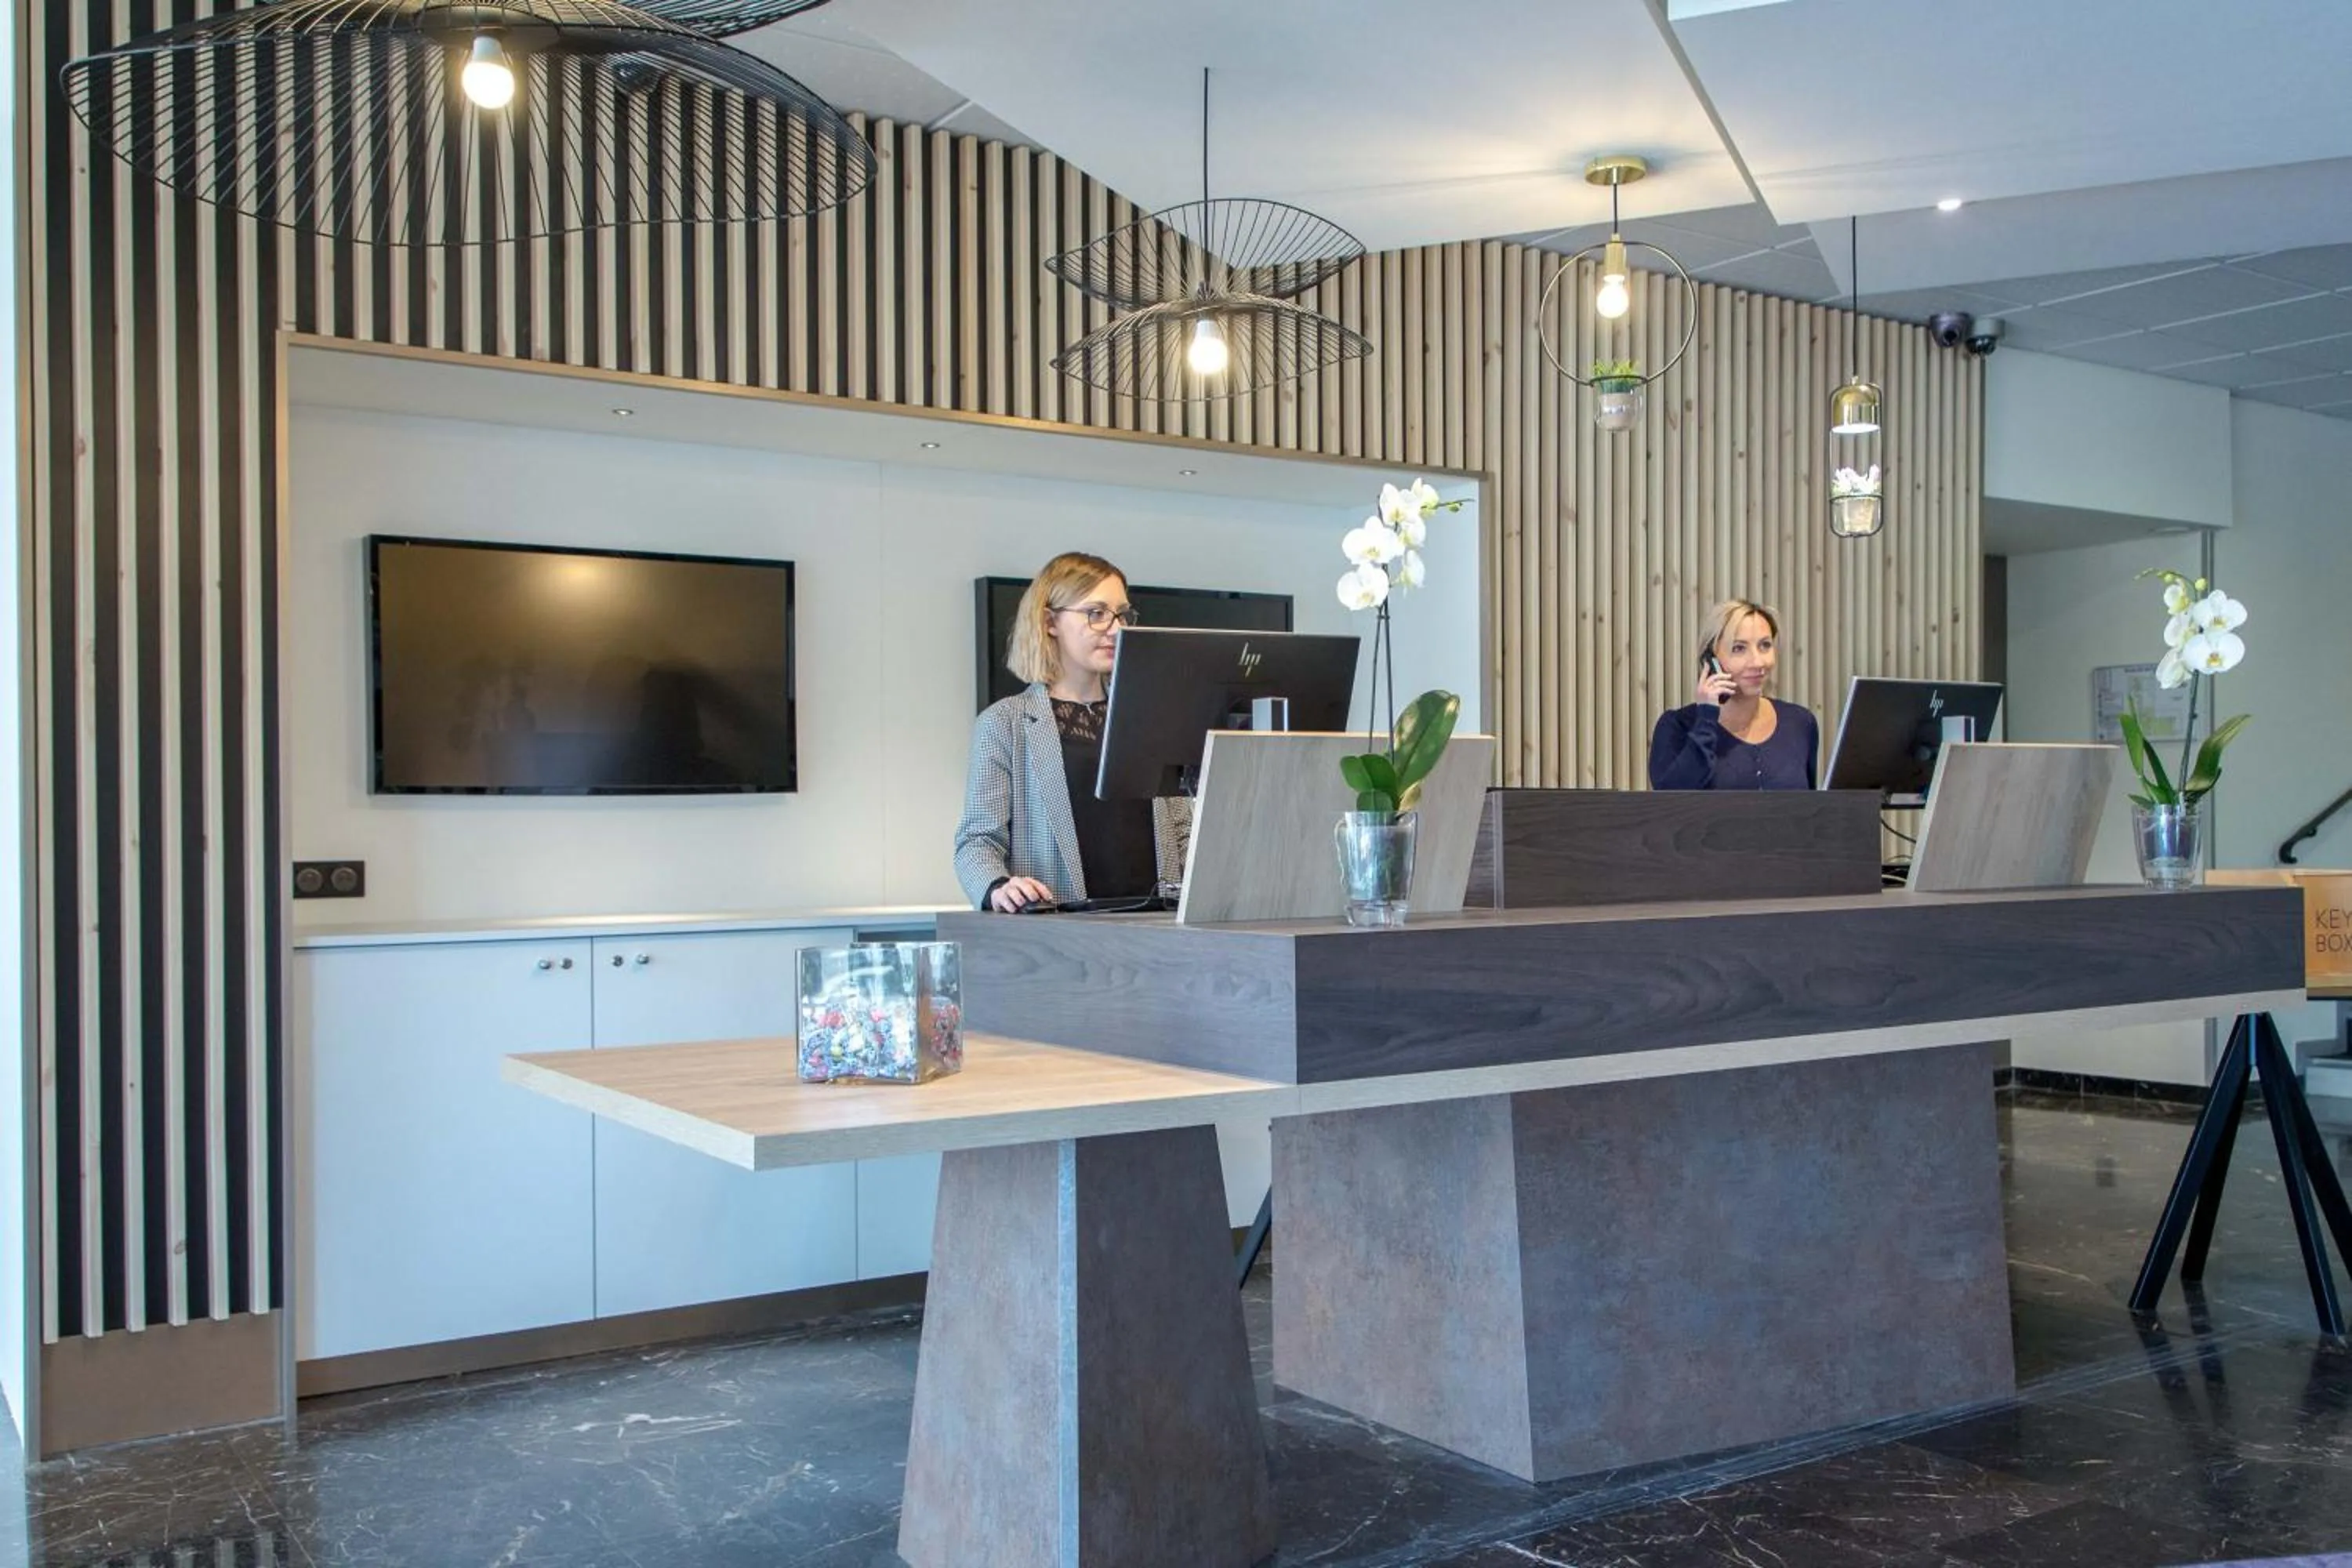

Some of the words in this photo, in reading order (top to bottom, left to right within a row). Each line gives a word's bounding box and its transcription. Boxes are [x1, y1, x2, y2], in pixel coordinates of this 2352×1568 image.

[1238, 641, 1261, 677] hp
[1929, 689, 1944, 718] hp
[2315, 909, 2352, 929] KEY
